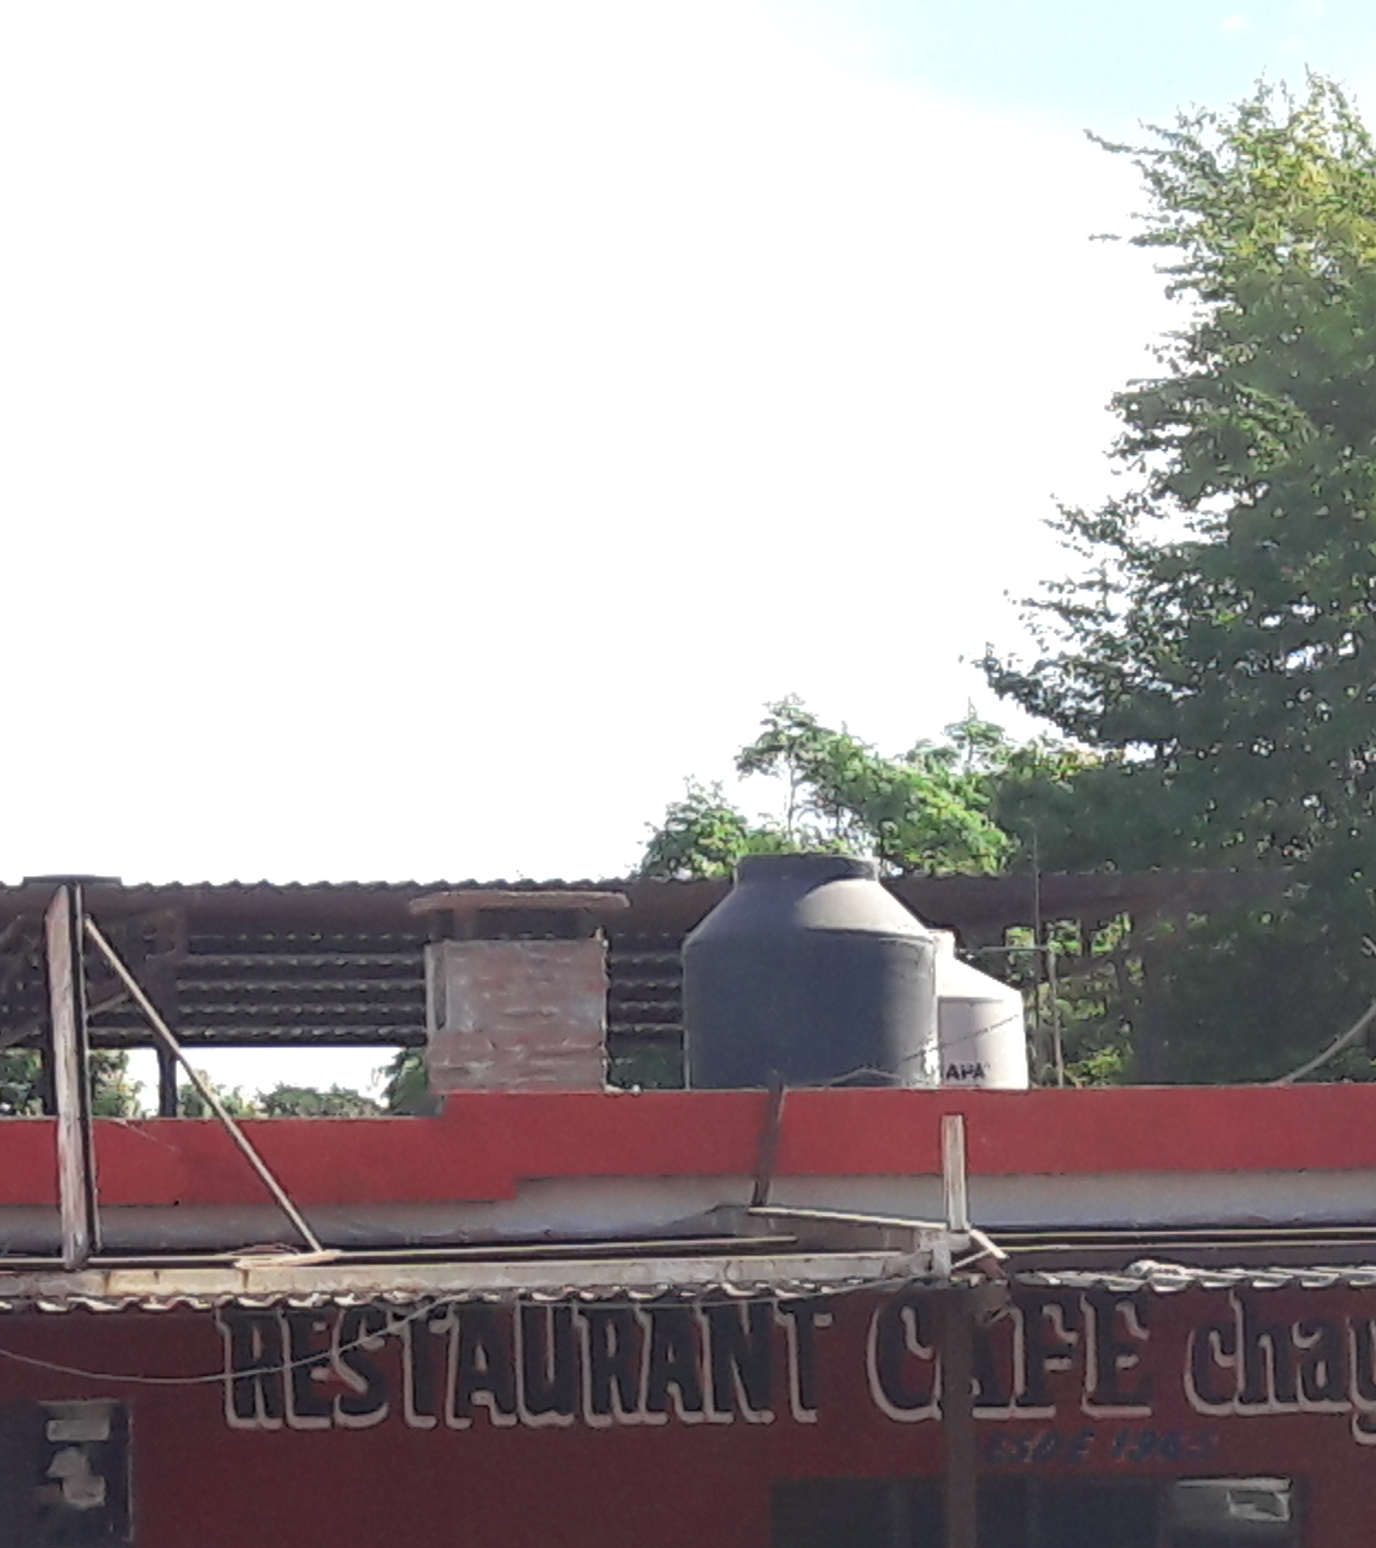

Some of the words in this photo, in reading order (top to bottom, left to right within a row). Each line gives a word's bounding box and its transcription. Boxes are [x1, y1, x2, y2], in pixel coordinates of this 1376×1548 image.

[940, 1062, 986, 1081] APA
[215, 1298, 835, 1429] RESTAURANT
[980, 1424, 1098, 1466] ESDE
